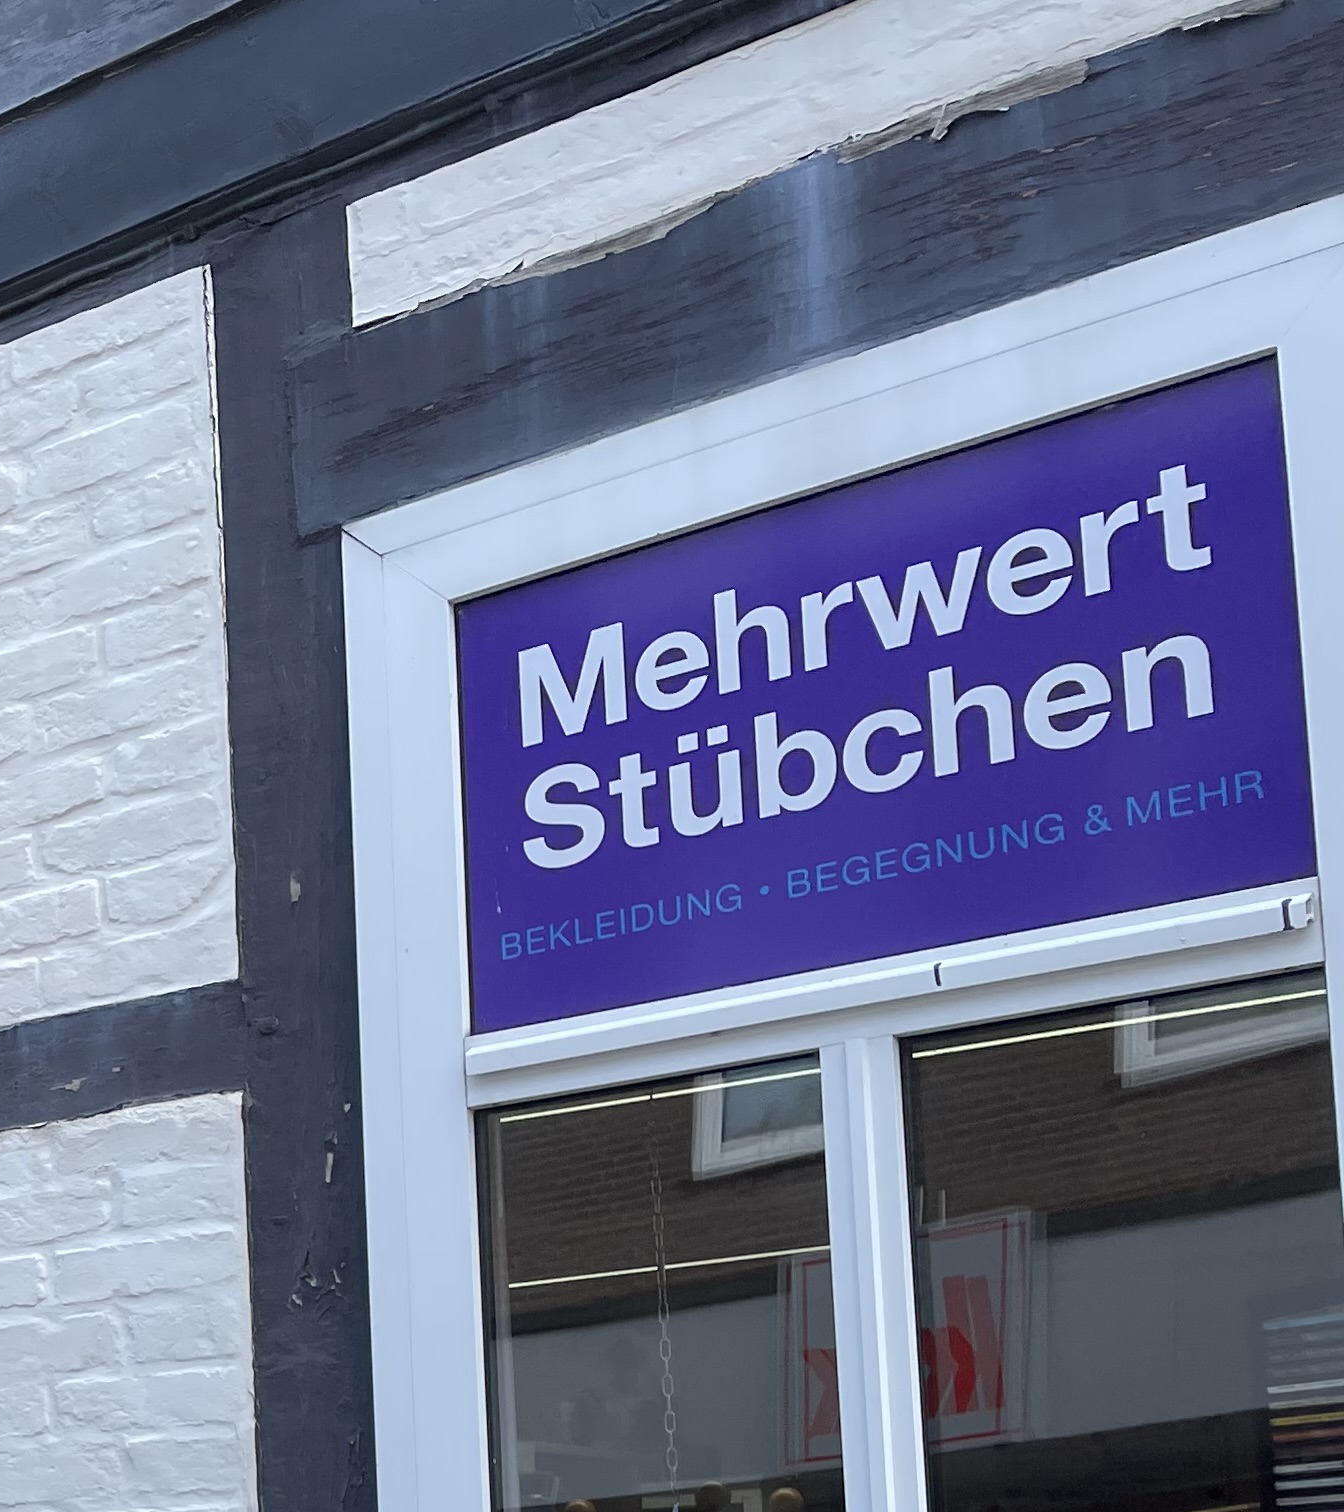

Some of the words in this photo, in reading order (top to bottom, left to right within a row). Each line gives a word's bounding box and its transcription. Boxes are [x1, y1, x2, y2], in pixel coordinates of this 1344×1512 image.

[517, 463, 1214, 749] Mehrwert
[499, 881, 744, 961] BEKLEIDUNG
[785, 811, 1067, 898] BEGEGNUNG
[1084, 804, 1114, 835] &
[1125, 769, 1266, 827] MEHR
[521, 633, 1216, 870] Stübchen
